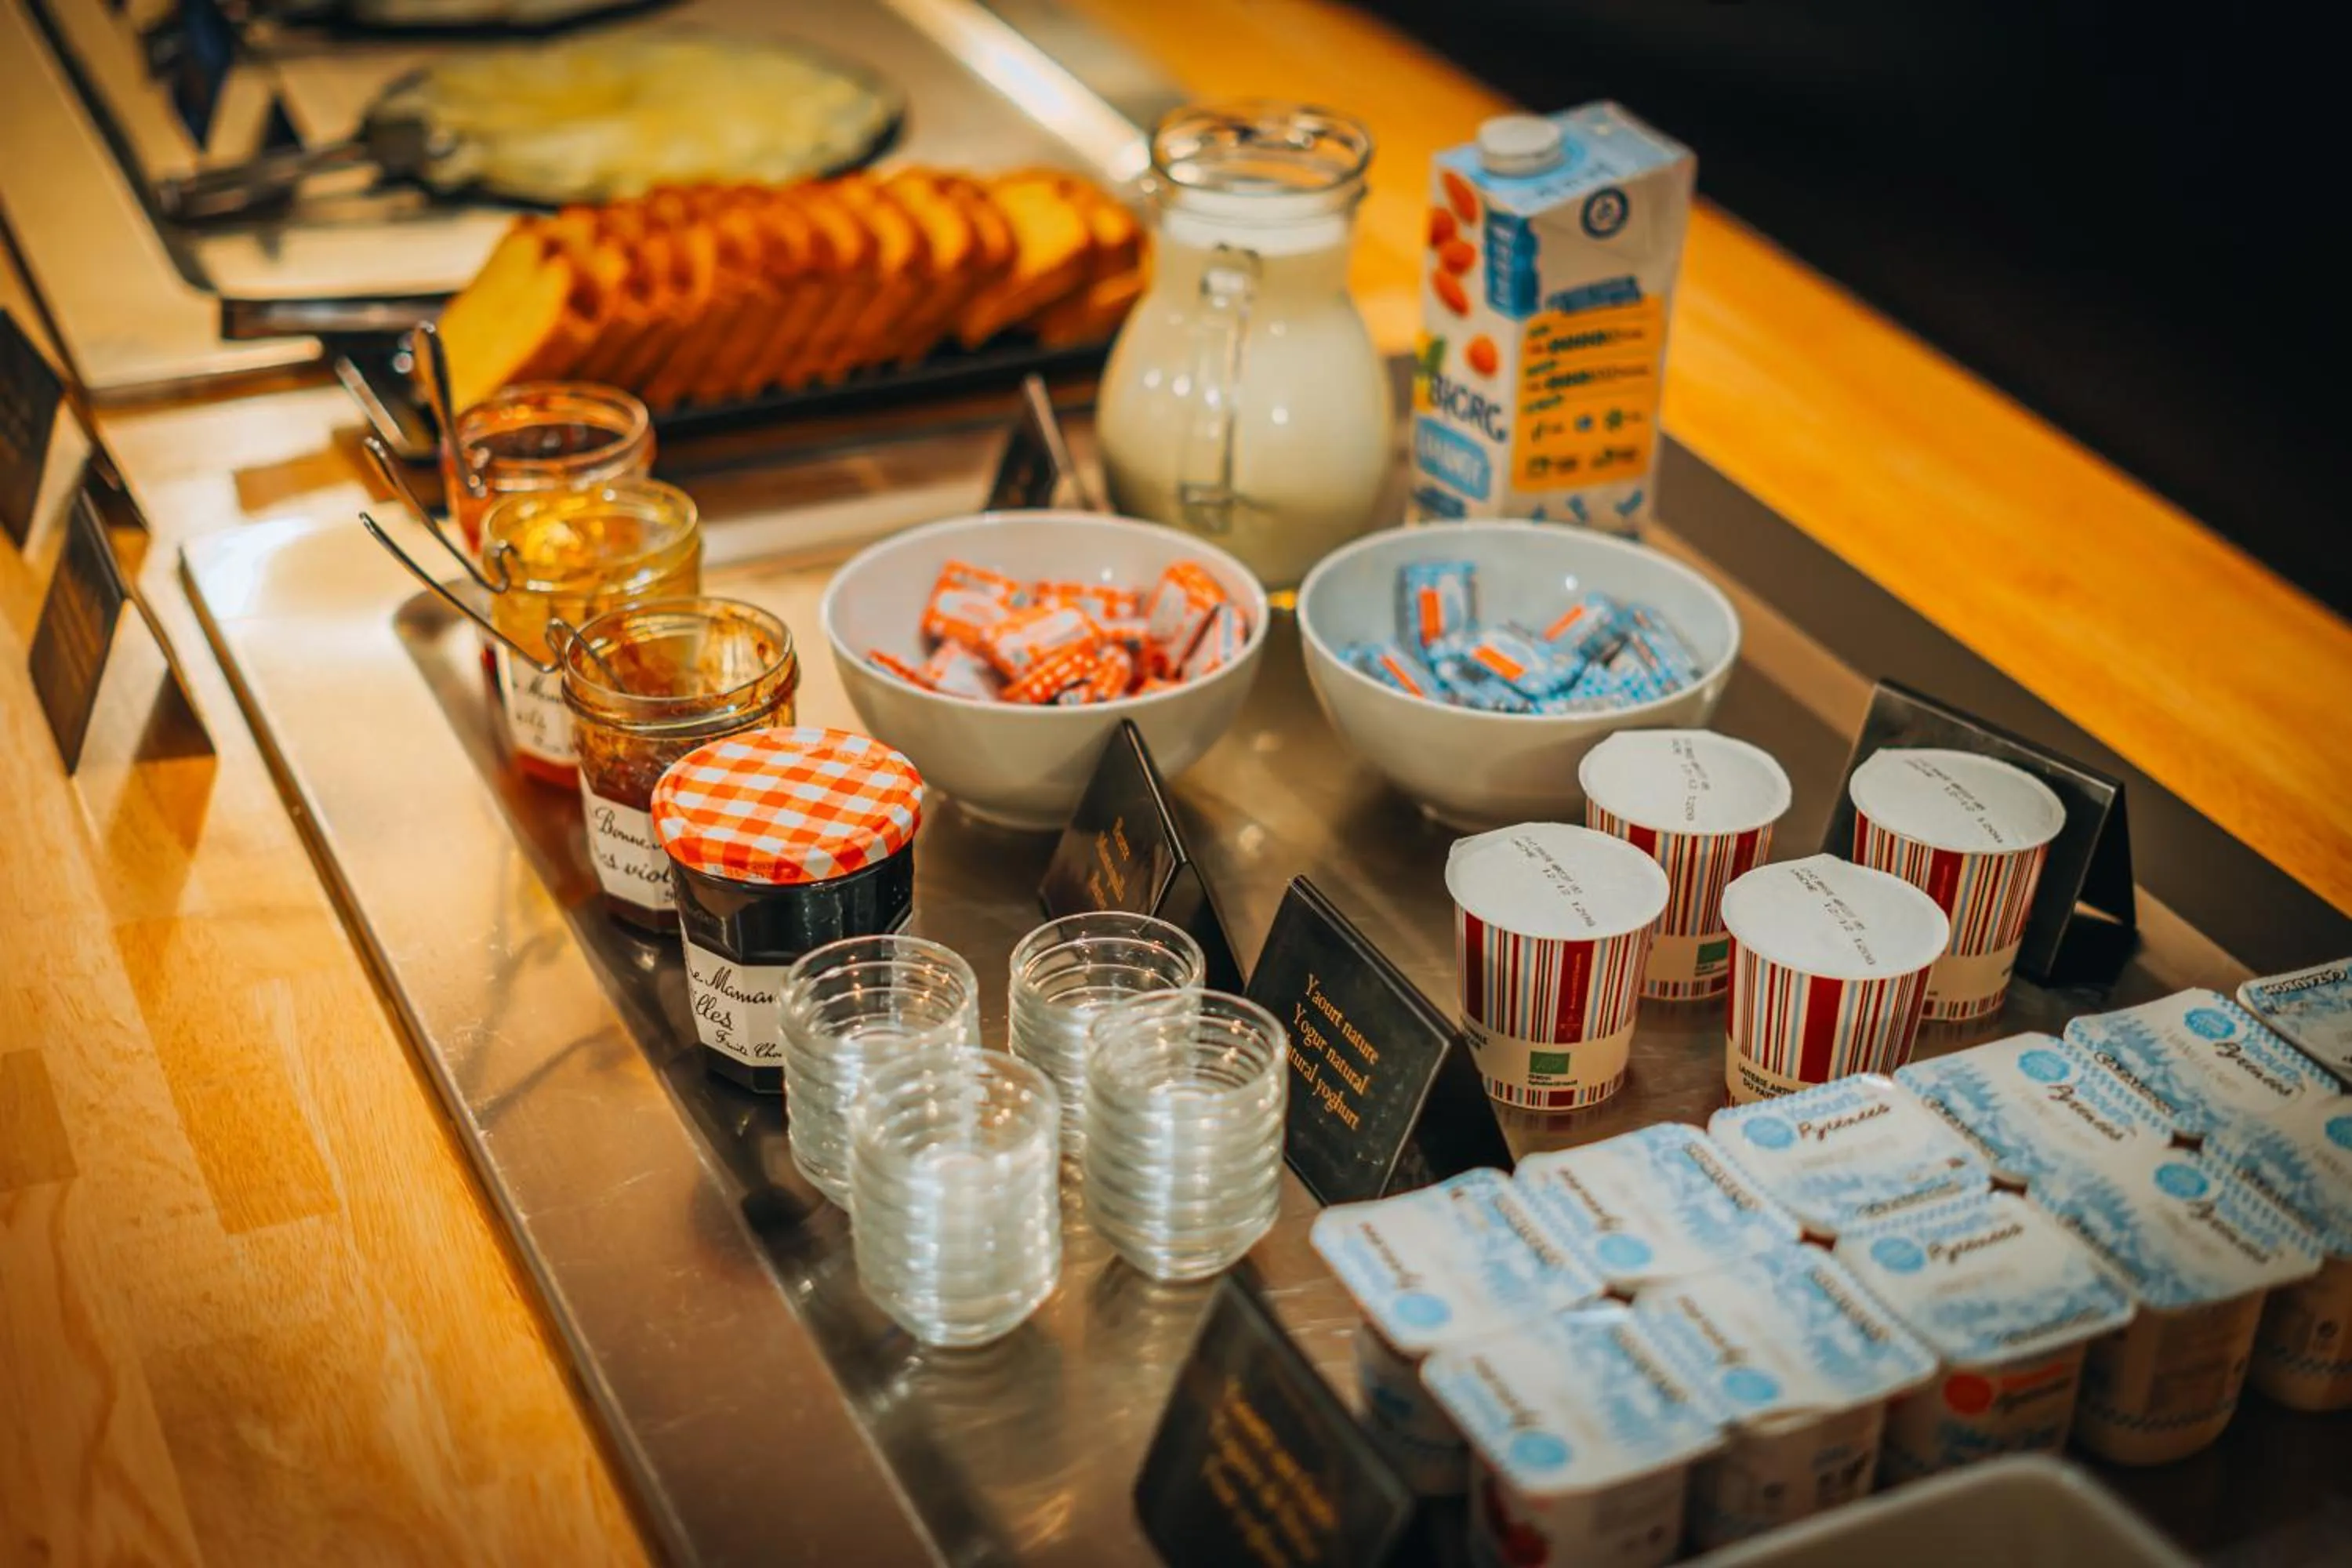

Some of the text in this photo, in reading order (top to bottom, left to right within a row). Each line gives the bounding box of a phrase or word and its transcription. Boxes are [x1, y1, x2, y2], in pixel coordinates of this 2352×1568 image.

[1294, 1002, 1370, 1096] Yogur natural
[1305, 972, 1379, 1065] Yaourt nature
[1312, 1078, 1360, 1131] yoghurt
